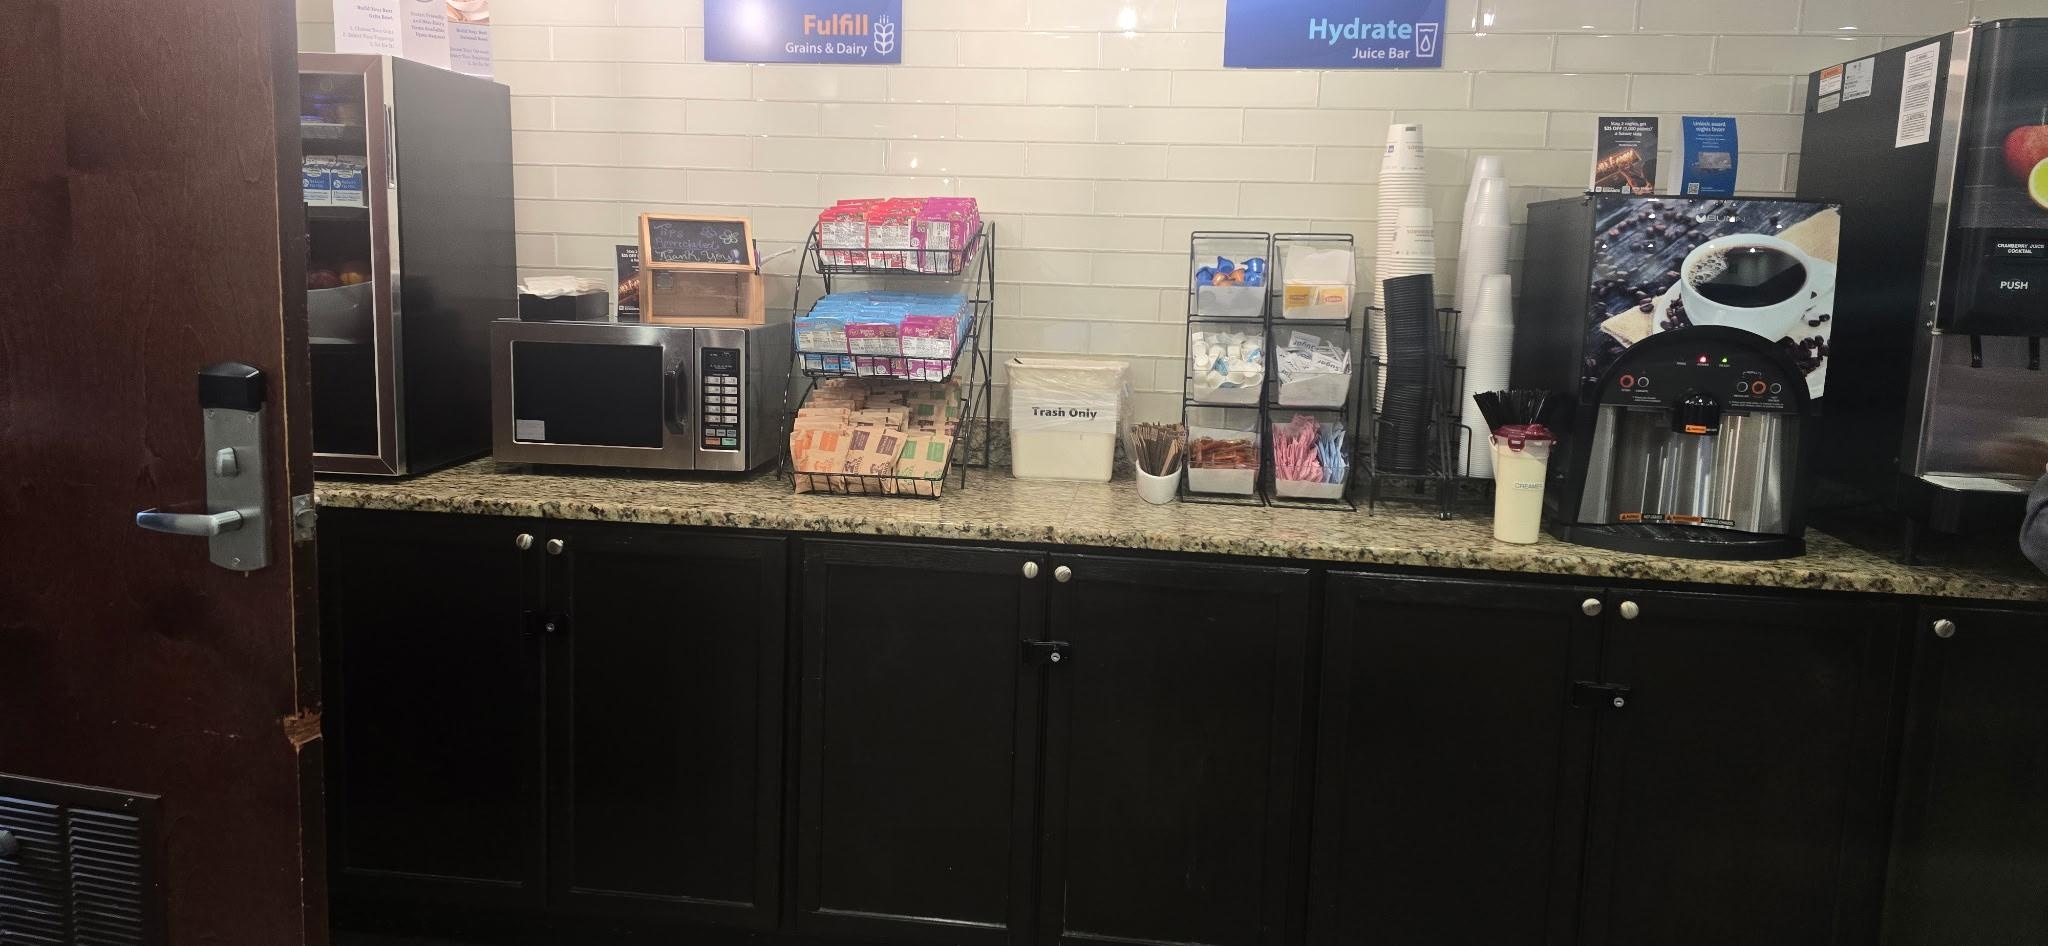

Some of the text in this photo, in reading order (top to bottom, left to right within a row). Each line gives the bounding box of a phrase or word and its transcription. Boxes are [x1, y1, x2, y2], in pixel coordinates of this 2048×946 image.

[803, 13, 869, 36] Fulfill
[1308, 17, 1413, 46] Hydrate
[785, 41, 868, 57] Grains & Dairy
[1352, 47, 1411, 59] Juice Bar
[655, 249, 700, 263] Thank
[1999, 281, 2029, 290] PUSH
[1031, 406, 1098, 421] Trash Only
